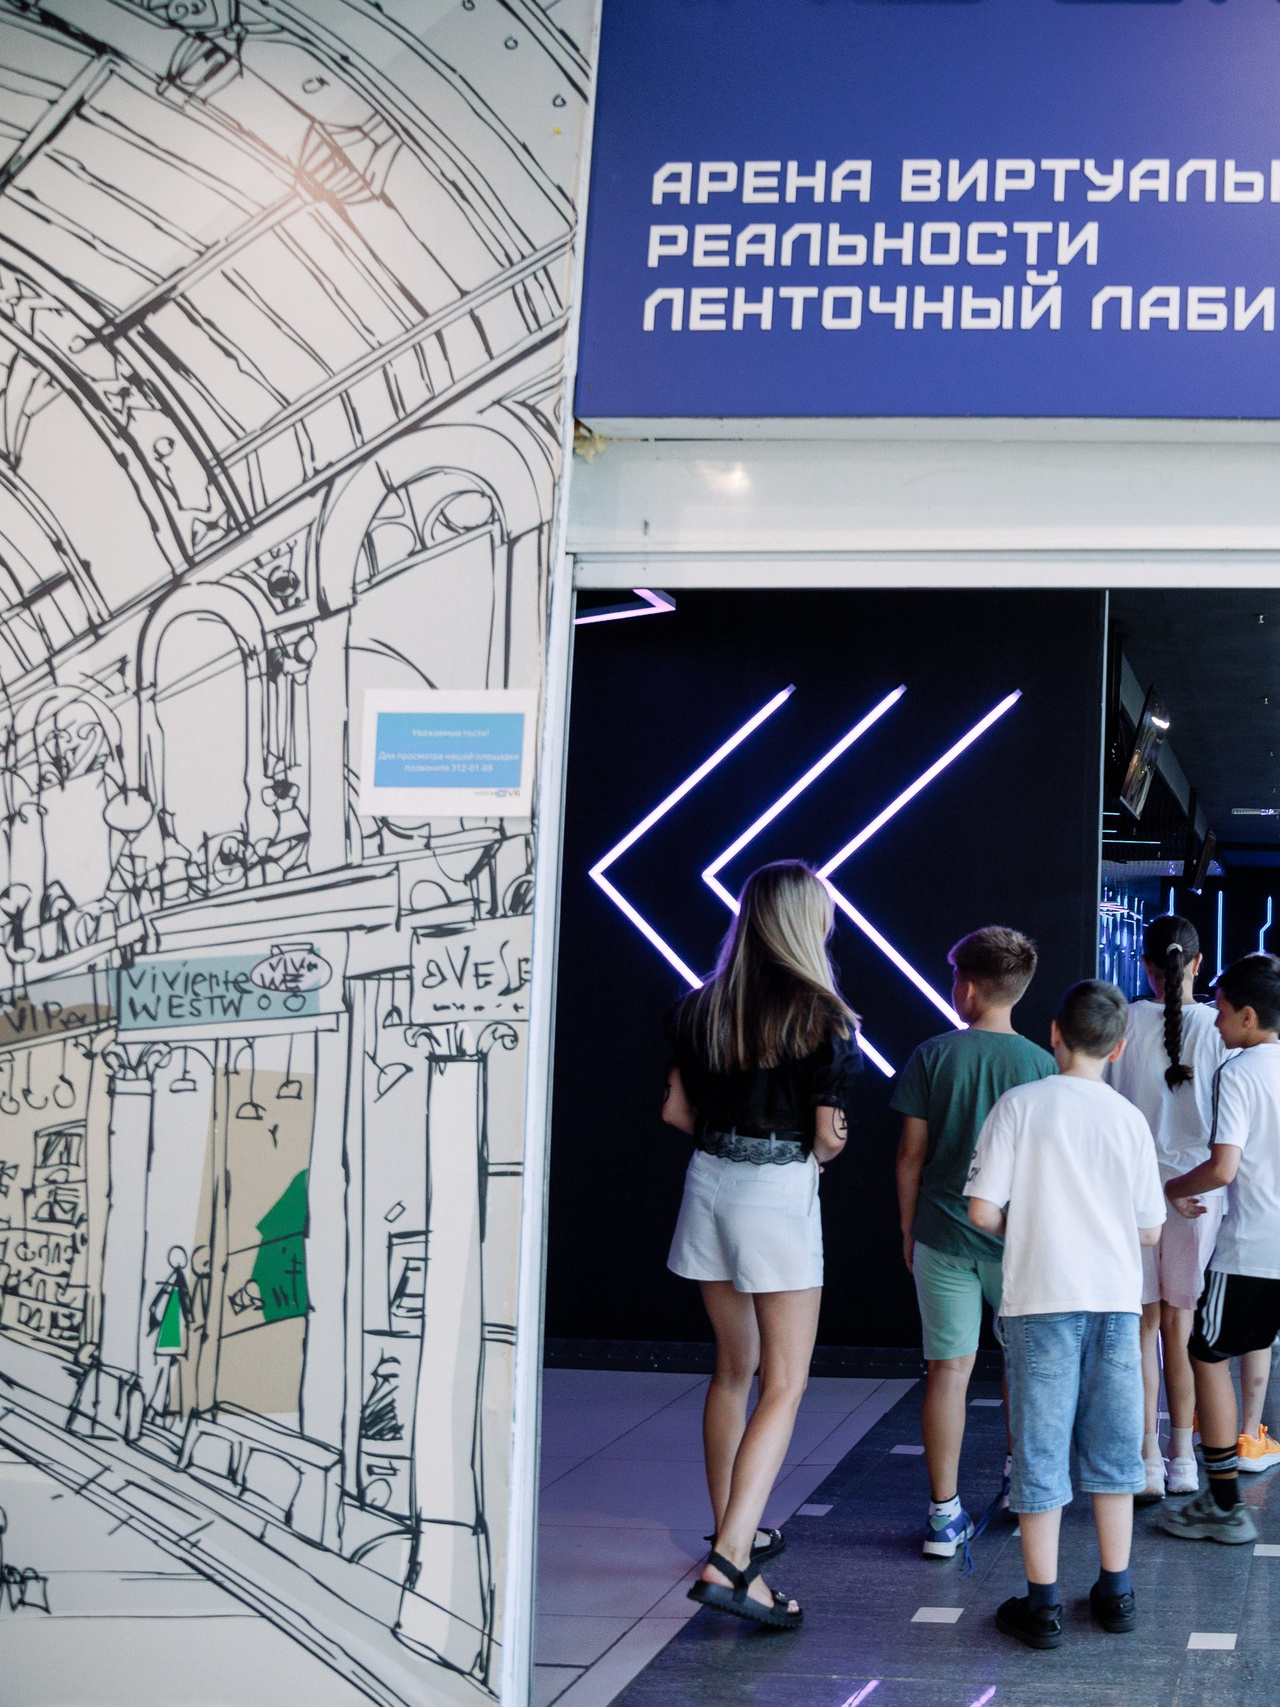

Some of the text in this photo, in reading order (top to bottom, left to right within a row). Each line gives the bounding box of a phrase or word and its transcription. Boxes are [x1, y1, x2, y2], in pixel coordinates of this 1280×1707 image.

[652, 160, 872, 205] АРЕНА
[647, 221, 1099, 268] РЕАЛЬНОСТИ
[643, 269, 1062, 331] ЛЕНТОЧНЫЙ
